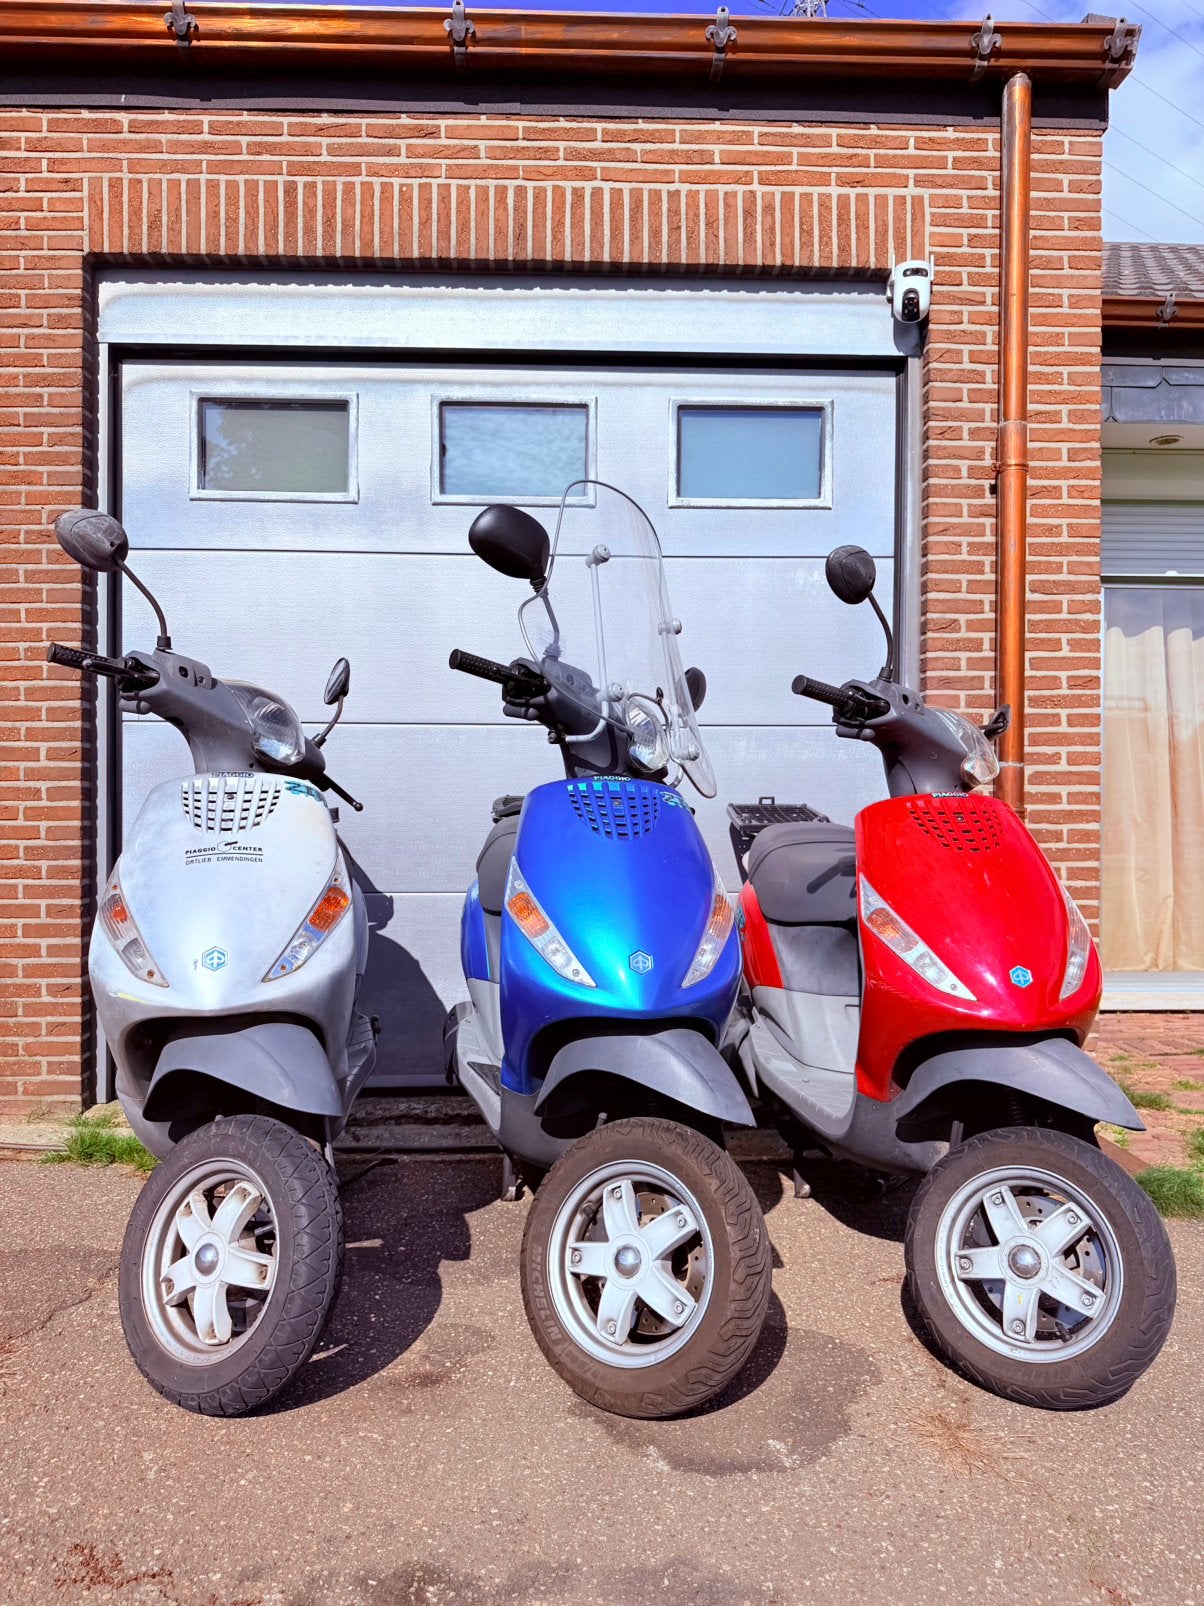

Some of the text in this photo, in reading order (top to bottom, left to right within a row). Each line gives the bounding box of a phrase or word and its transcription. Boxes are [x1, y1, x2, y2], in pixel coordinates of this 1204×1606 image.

[185, 846, 216, 855] PIAGGIO
[185, 857, 212, 866] ORTLIEB
[531, 1243, 562, 1340] MICHELIN
